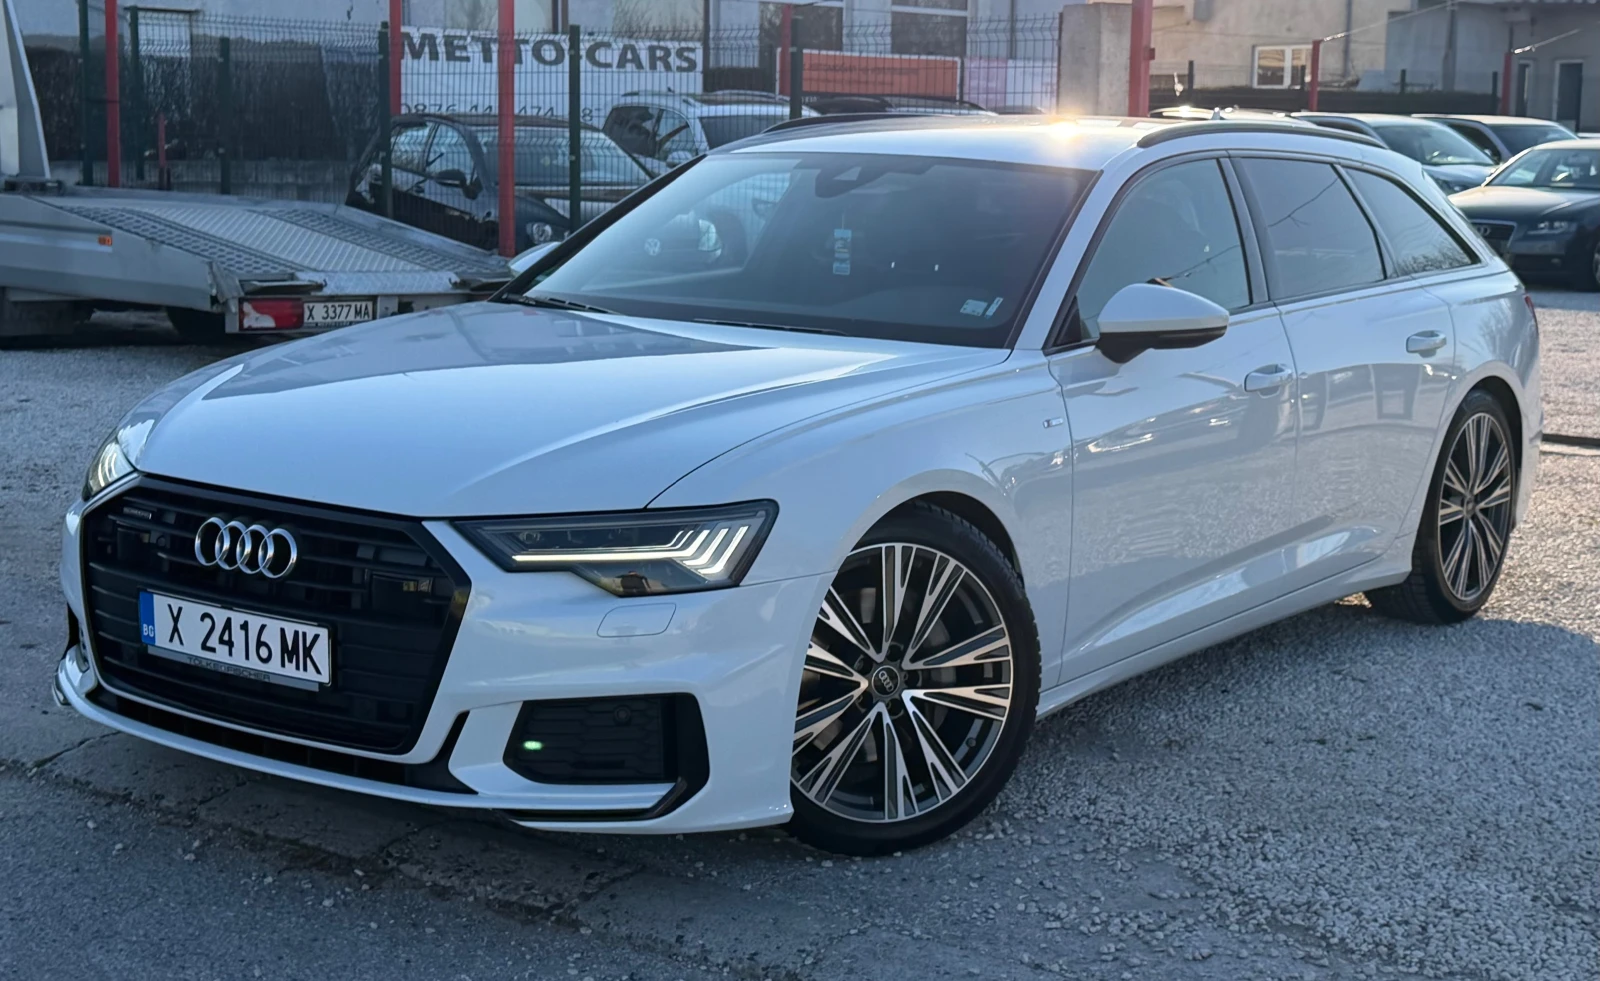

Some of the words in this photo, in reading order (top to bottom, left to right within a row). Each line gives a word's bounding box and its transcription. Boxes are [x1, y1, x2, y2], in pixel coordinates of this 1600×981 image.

[307, 305, 315, 320] X
[322, 304, 352, 320] 3377
[354, 303, 370, 319] MA
[143, 624, 154, 637] BG
[167, 603, 184, 646] X
[200, 612, 273, 664] 2416
[280, 627, 323, 676] MK
